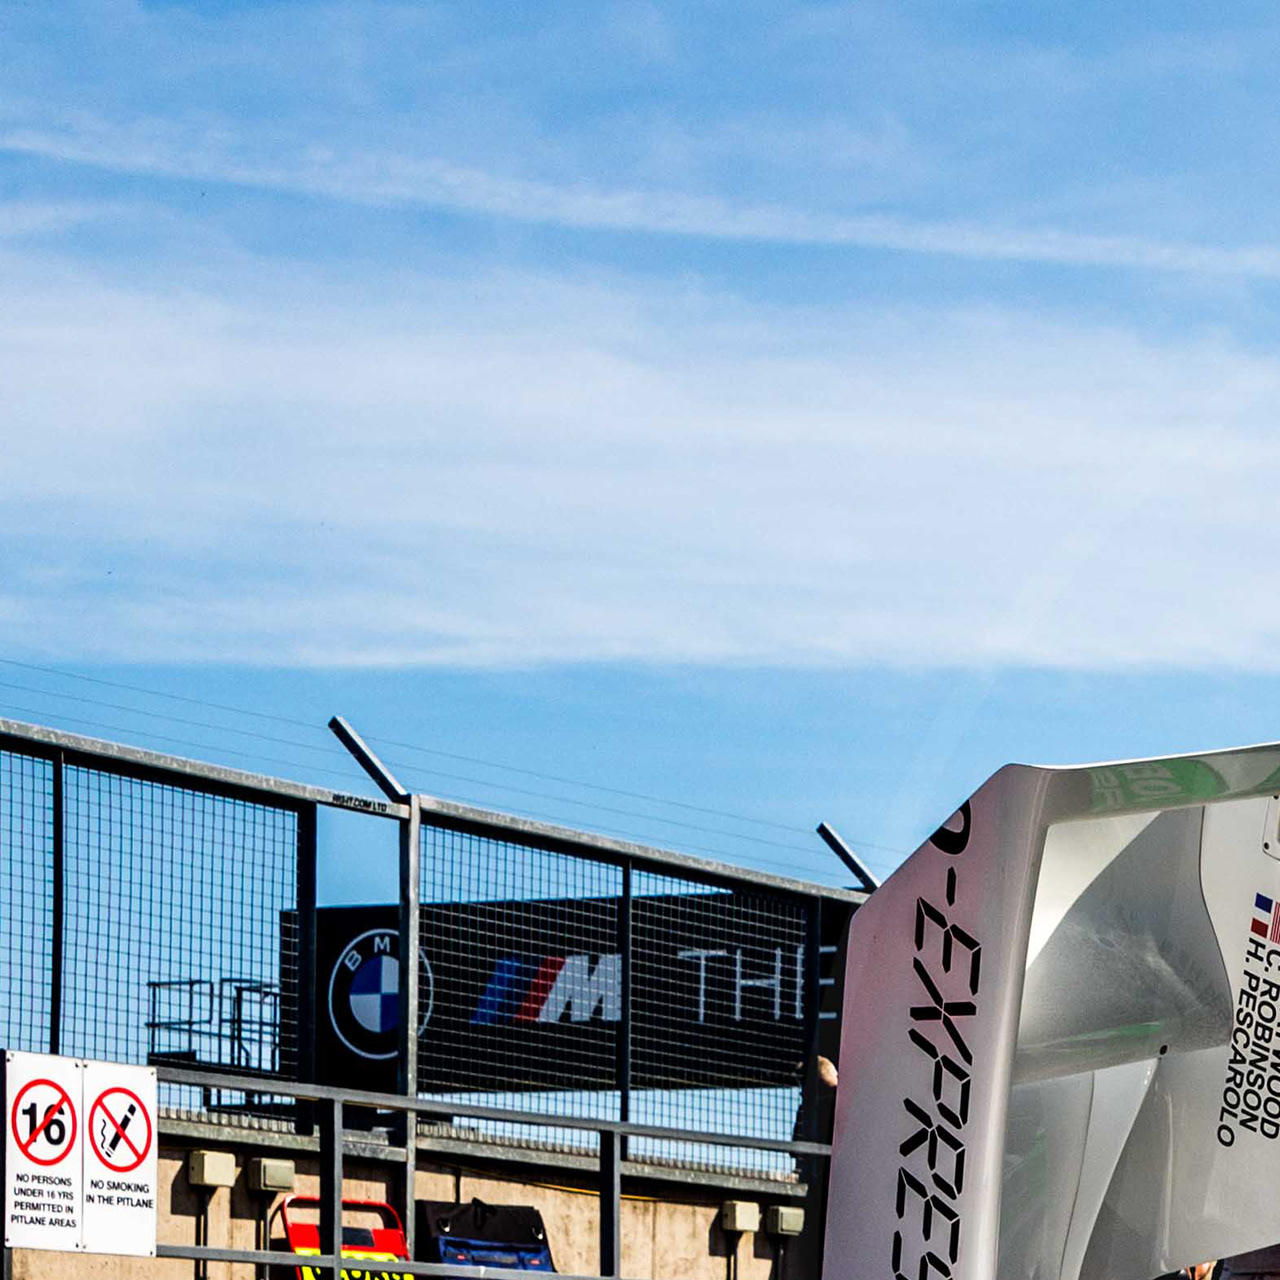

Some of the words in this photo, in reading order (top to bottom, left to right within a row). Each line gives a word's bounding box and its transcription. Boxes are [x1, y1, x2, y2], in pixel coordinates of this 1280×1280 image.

[676, 946, 838, 1025] THE
[1216, 968, 1261, 1148] PESCAROLO
[21, 1101, 67, 1146] 16
[16, 1173, 29, 1183] NO
[31, 1174, 72, 1187] PERSONS
[90, 1180, 105, 1190] NO
[106, 1182, 150, 1194] SMOKING
[13, 1187, 44, 1198] UNDER
[46, 1189, 56, 1199] 16
[57, 1190, 74, 1201] YRS
[14, 1201, 63, 1214] PERMITTED
[65, 1205, 74, 1214] IN
[86, 1194, 95, 1204] IN
[97, 1195, 115, 1206] THE
[116, 1197, 154, 1209] PITLANE
[11, 1214, 51, 1226] PITLANE
[48, 1217, 77, 1228] AREAS
